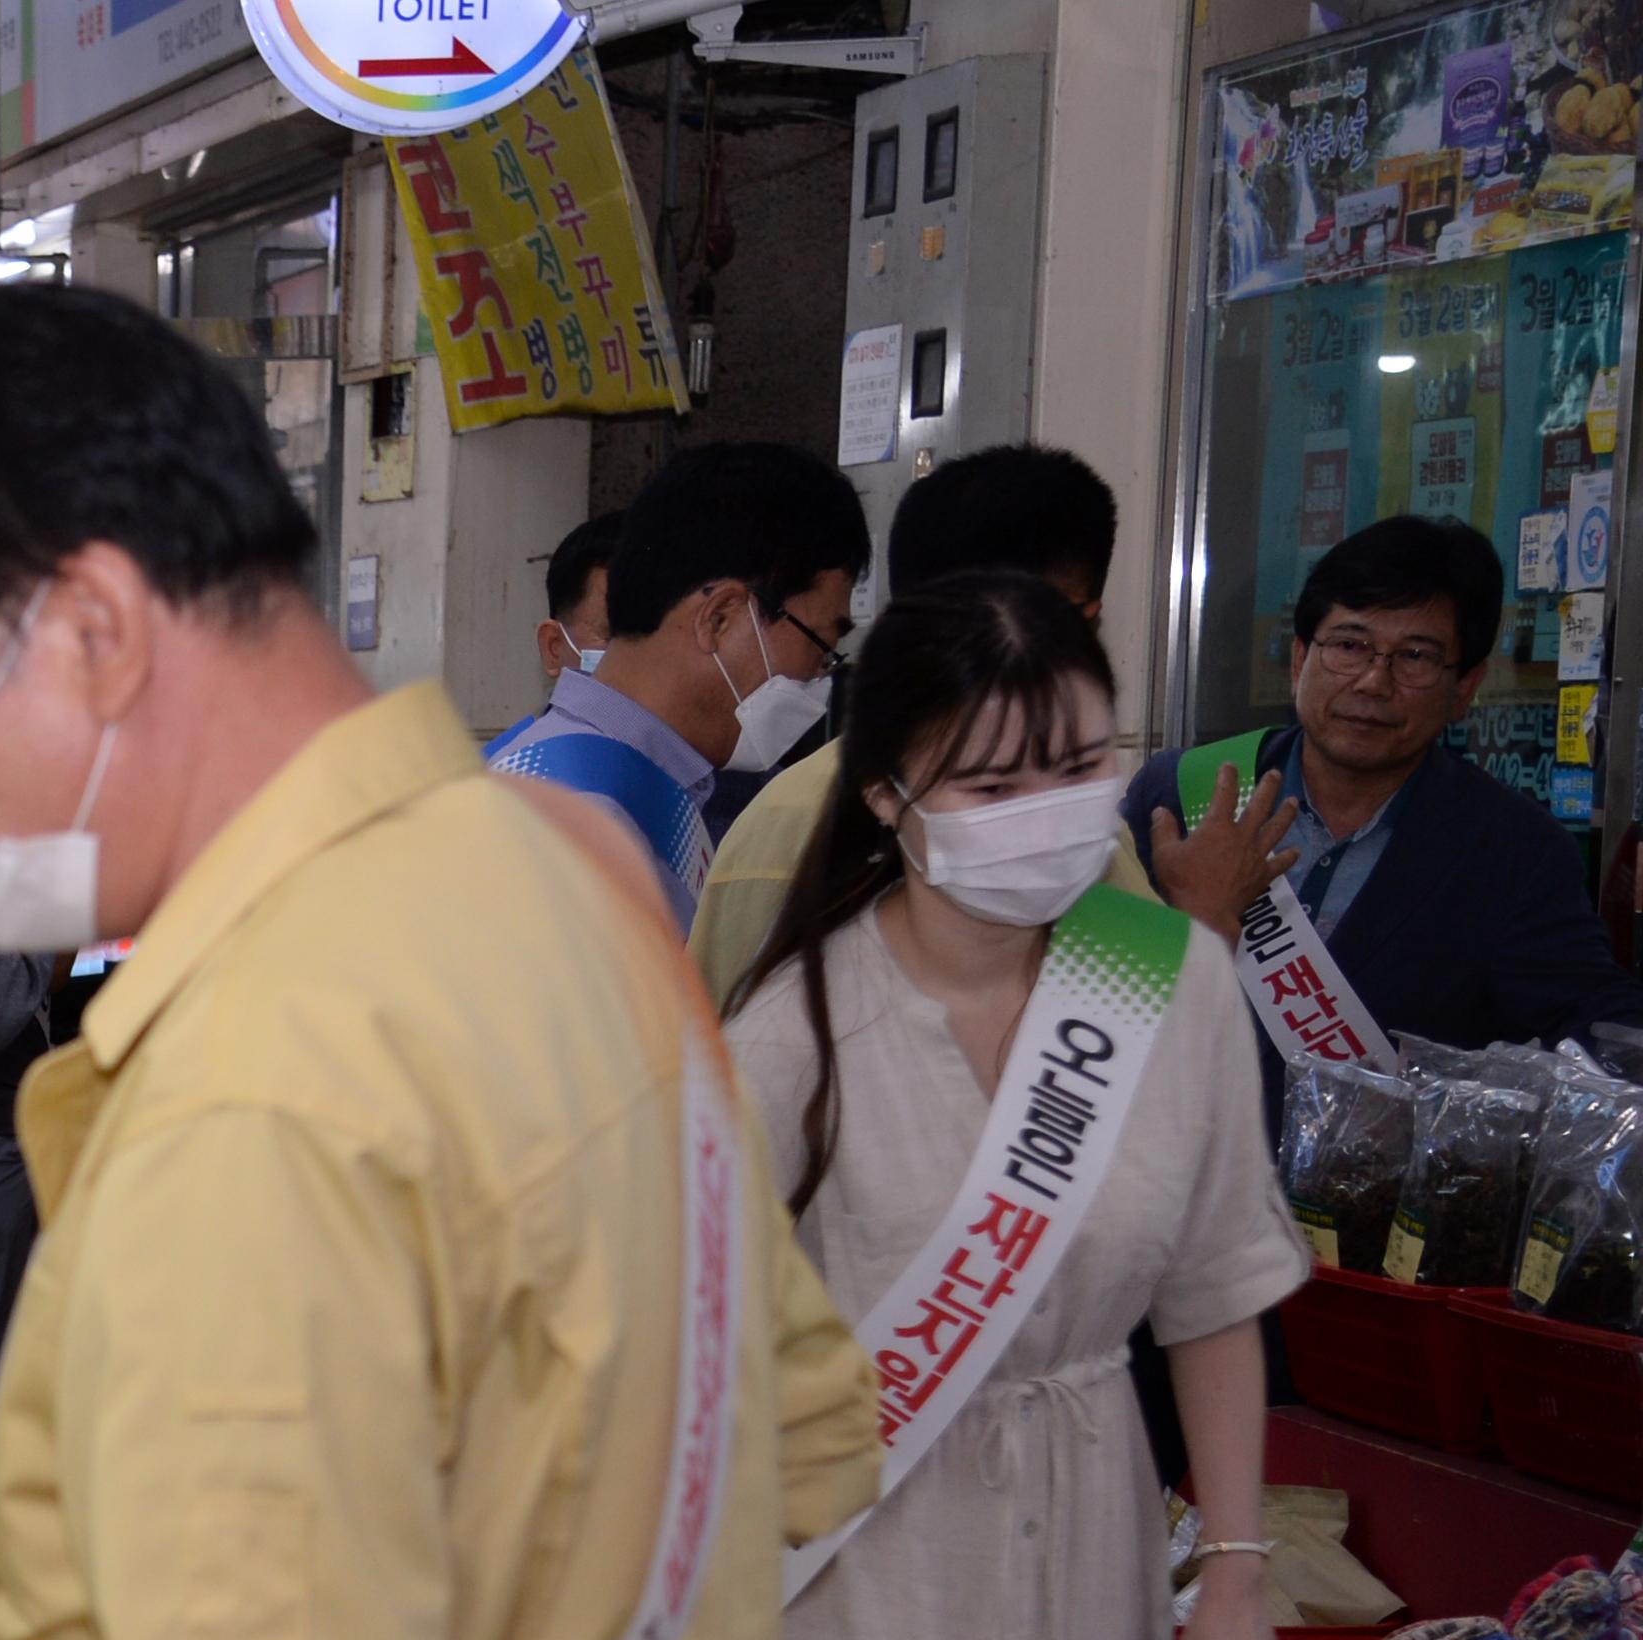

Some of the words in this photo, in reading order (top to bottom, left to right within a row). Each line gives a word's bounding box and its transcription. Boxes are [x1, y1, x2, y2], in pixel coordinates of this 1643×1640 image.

[845, 51, 896, 62] SAMSUNG
[1519, 273, 1557, 333] 3월
[1003, 1016, 1117, 1200] 오늘은
